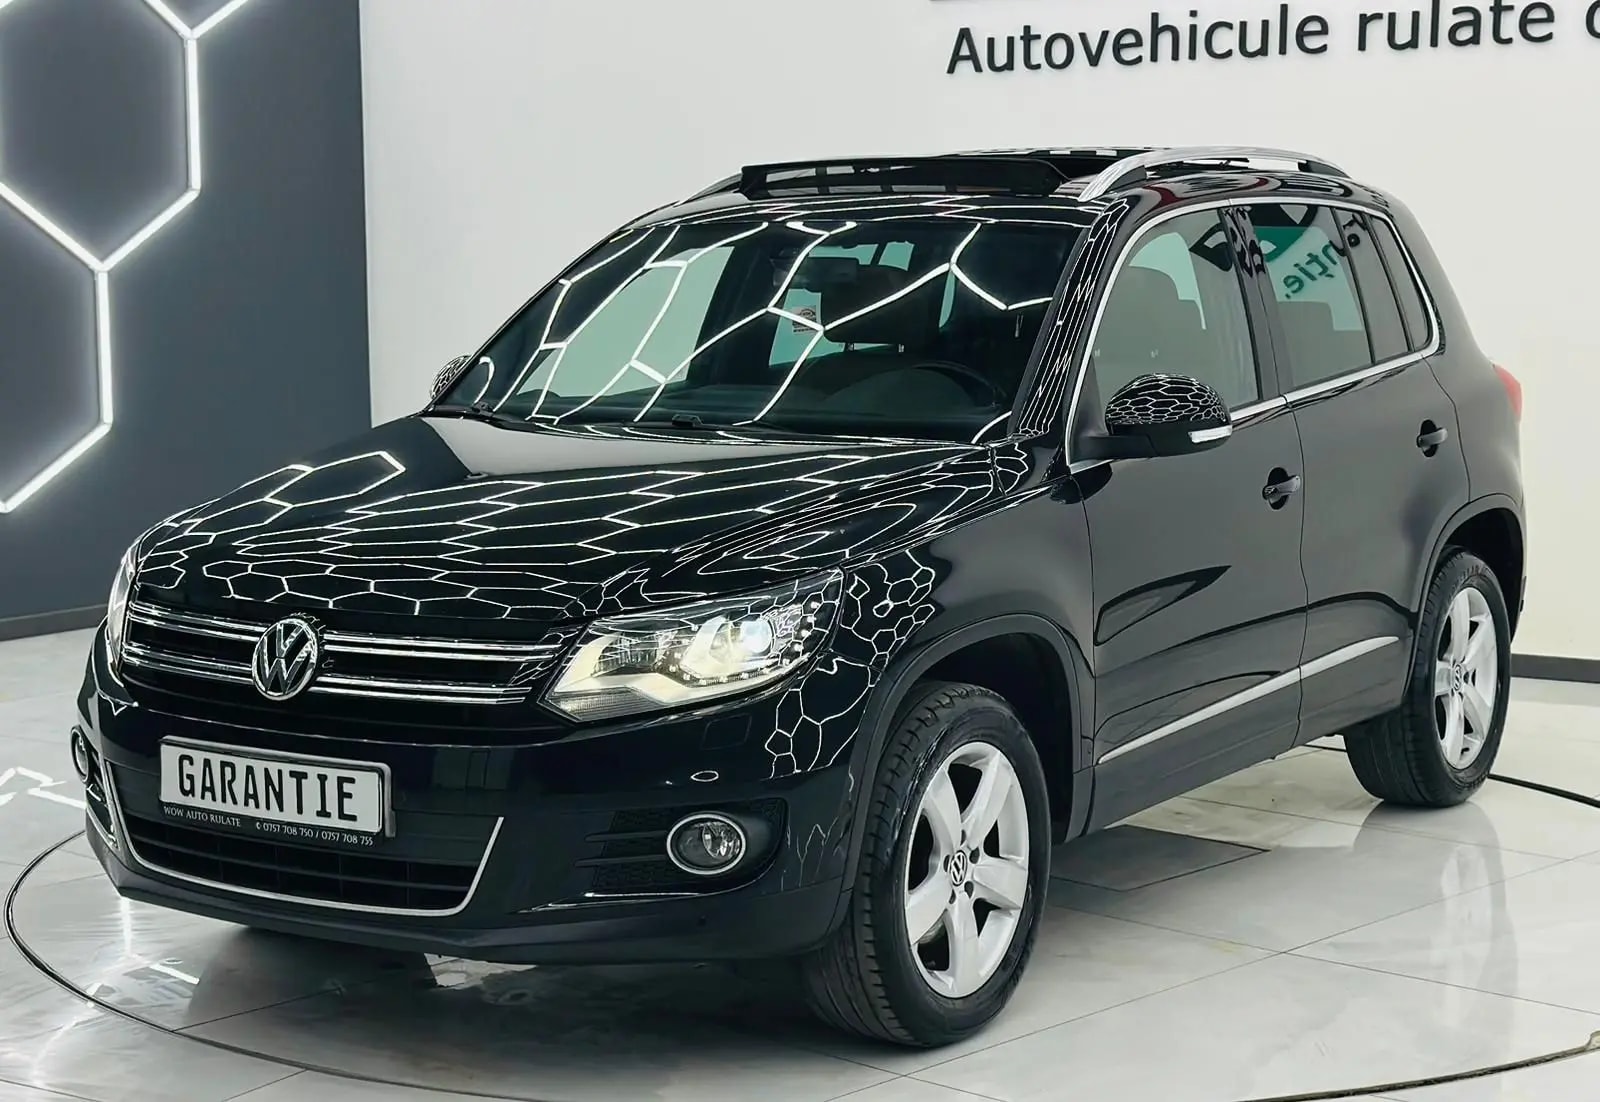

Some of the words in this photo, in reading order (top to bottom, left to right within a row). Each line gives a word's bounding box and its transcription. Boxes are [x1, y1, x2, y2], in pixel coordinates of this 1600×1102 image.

[946, 11, 1329, 74] Autovehicule
[1357, 0, 1555, 51] rulate
[178, 754, 358, 821] GARANTIE
[163, 806, 184, 817] WOW
[185, 809, 209, 821] AUTO
[209, 813, 241, 828] RULATE
[262, 822, 281, 833] 0757
[282, 824, 298, 837] 708
[299, 827, 314, 838] 750
[321, 830, 340, 842] 0757
[341, 832, 358, 845] 708
